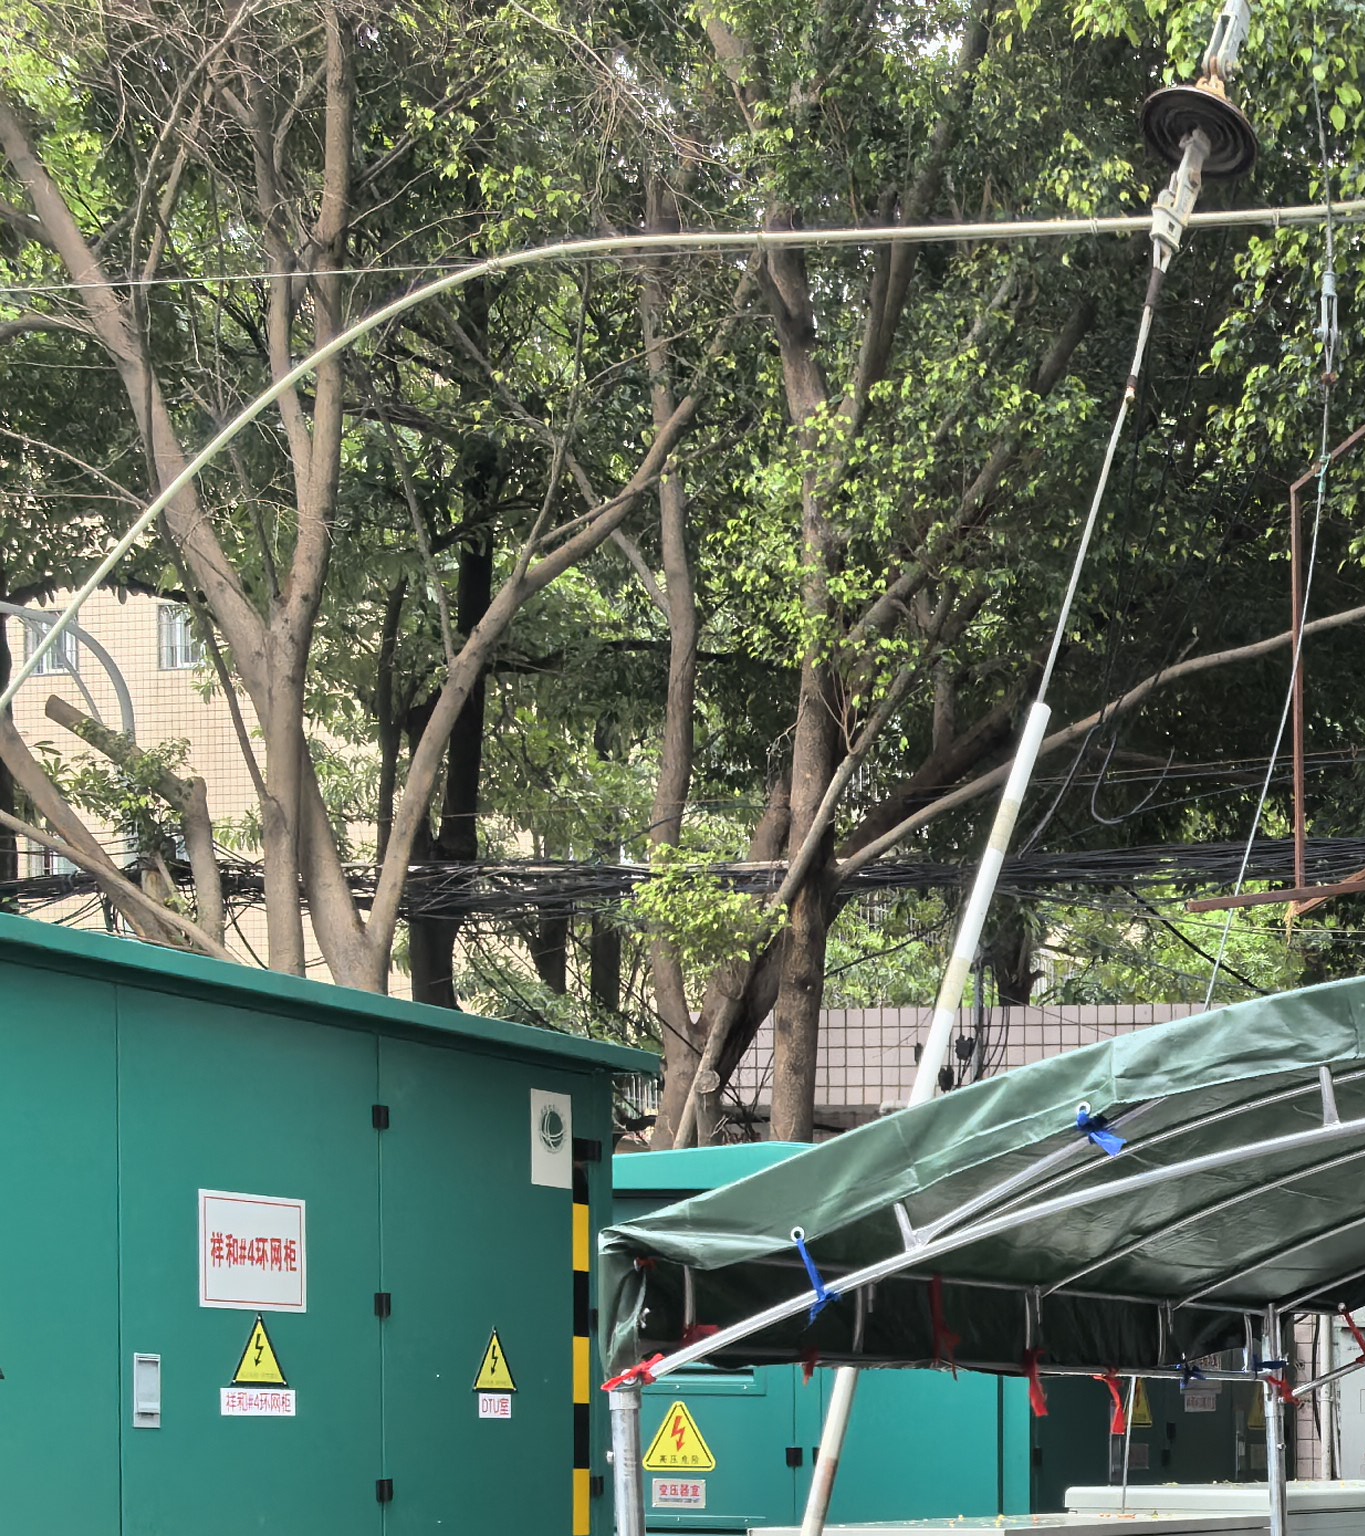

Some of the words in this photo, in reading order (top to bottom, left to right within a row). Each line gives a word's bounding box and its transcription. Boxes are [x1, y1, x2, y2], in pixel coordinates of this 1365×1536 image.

[211, 1231, 297, 1272] 祥和#4环网柜
[226, 1391, 292, 1413] 祥和#4环网柜
[481, 1398, 509, 1416] DTU室
[659, 1484, 700, 1497] 变压器室
